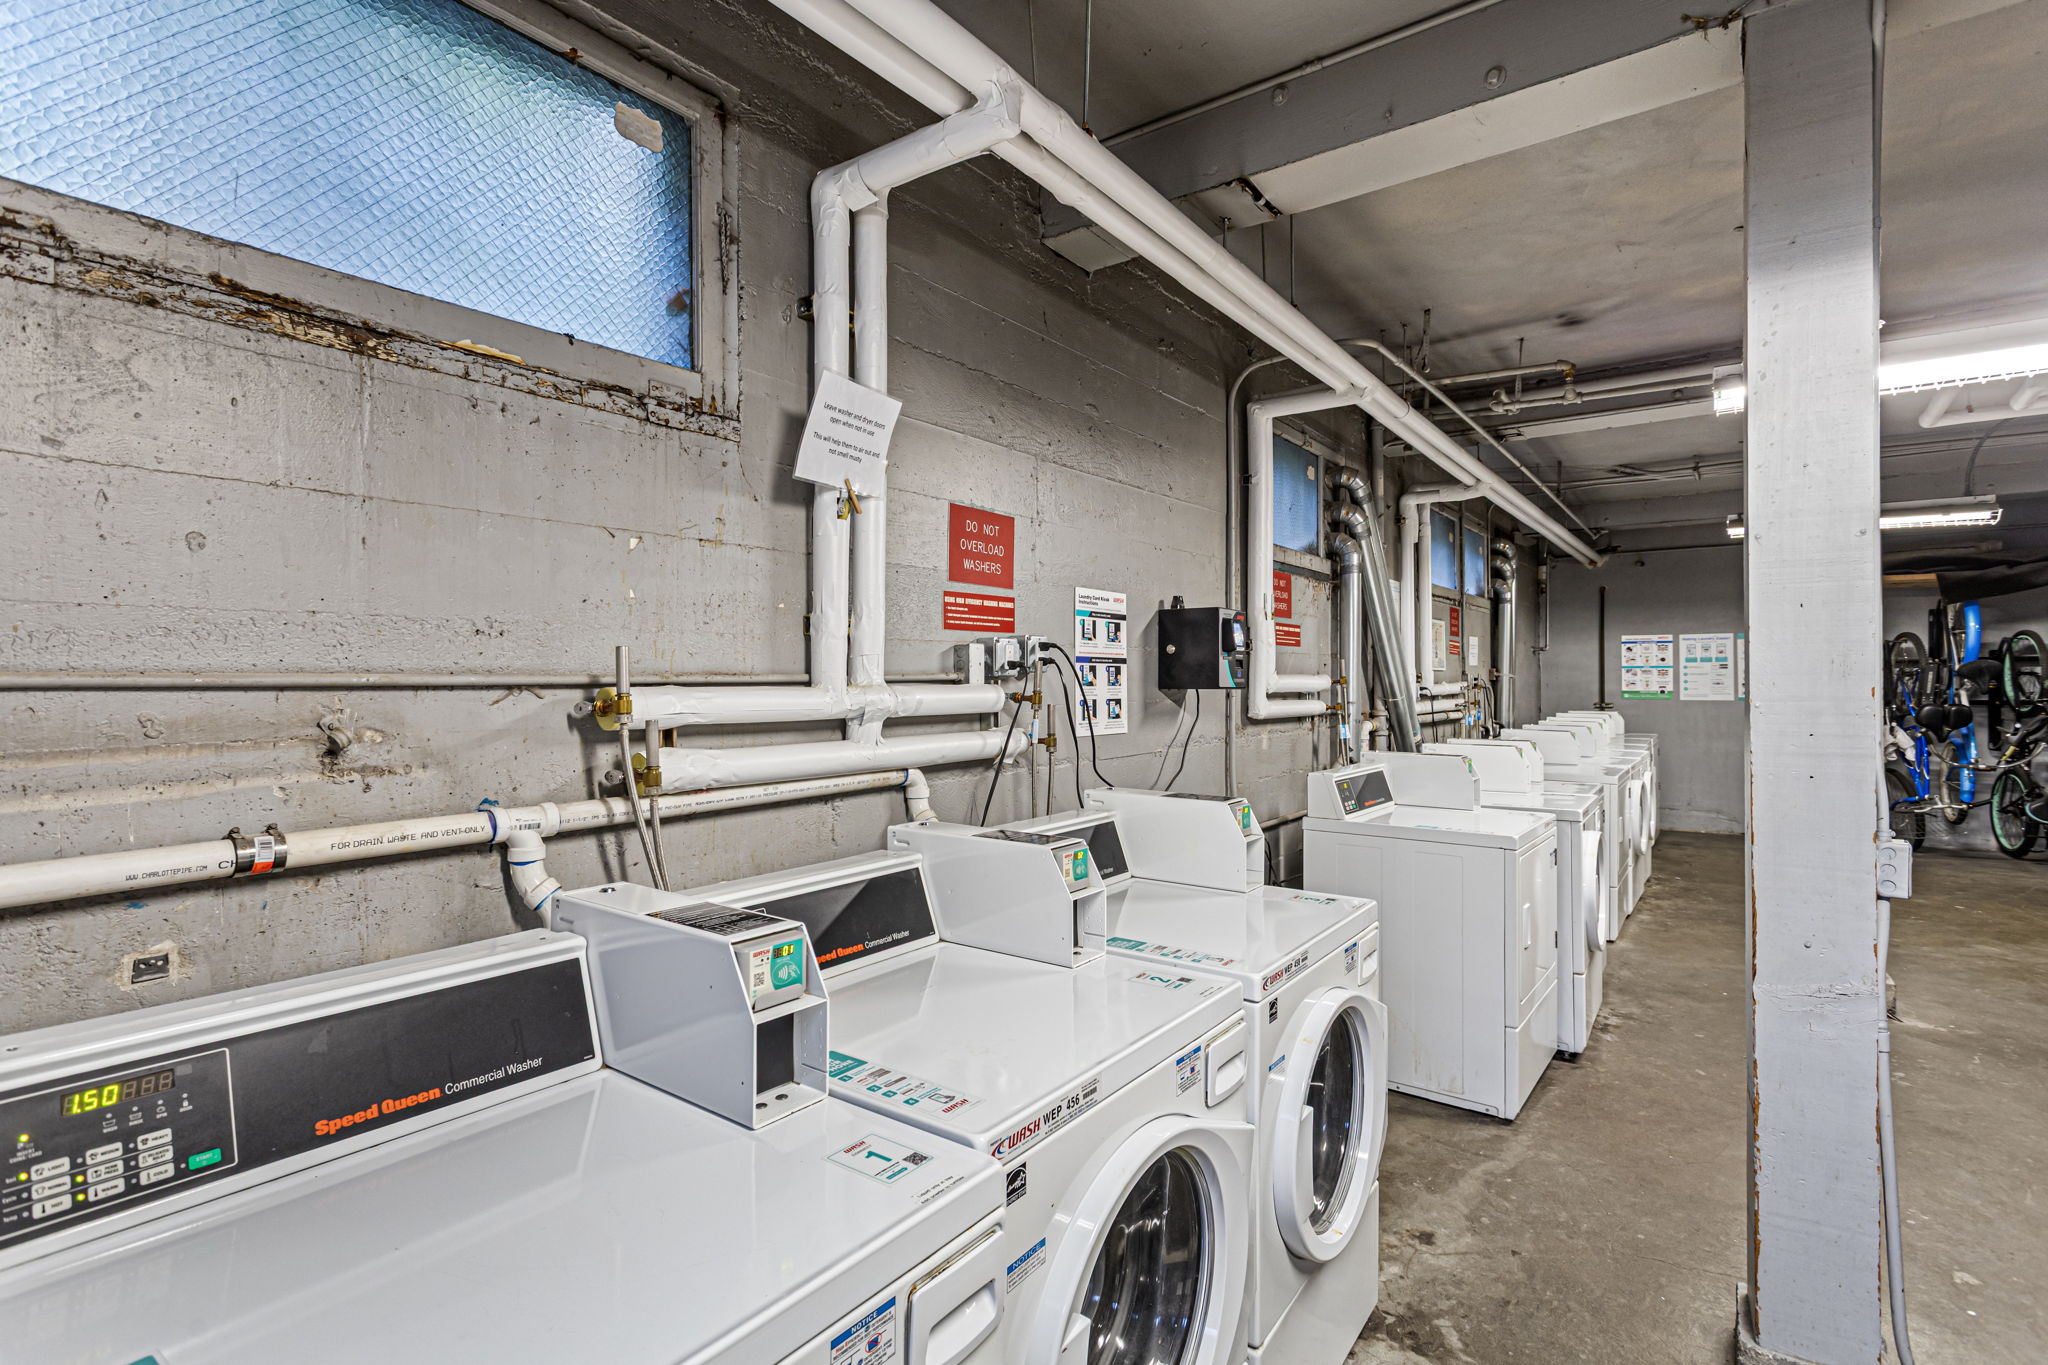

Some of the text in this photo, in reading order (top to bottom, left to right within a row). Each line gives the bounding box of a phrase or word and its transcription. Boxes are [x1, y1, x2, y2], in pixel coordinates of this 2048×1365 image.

[824, 402, 837, 411] Leave
[838, 408, 854, 417] washer
[862, 416, 874, 425] dryer
[874, 421, 886, 430] doors
[842, 421, 854, 429] when
[814, 431, 822, 440] This
[831, 438, 841, 446] help
[842, 441, 852, 449] them
[966, 520, 999, 536] DO NOT
[960, 539, 1005, 557] OVERLOAD
[963, 558, 1002, 575] WASHERS
[331, 841, 350, 850] FOR
[353, 837, 383, 849] DRAIN
[388, 833, 416, 844] WASTE
[421, 830, 439, 839] AND
[837, 944, 864, 957] Queen
[864, 934, 892, 949] Commercial
[893, 930, 910, 940] Washer
[72, 1084, 119, 1114] 1.50
[315, 1056, 543, 1136] Speed Queen Commercial Washer
[942, 1098, 969, 1113] WASH
[1008, 1117, 1040, 1149] WASH
[1043, 1105, 1062, 1125] WEP
[1066, 1094, 1079, 1110] 456
[844, 1141, 865, 1154] WASH
[865, 1150, 893, 1162] 1
[1013, 1244, 1040, 1269] NOTICE
[851, 1310, 878, 1334] NOTICE
